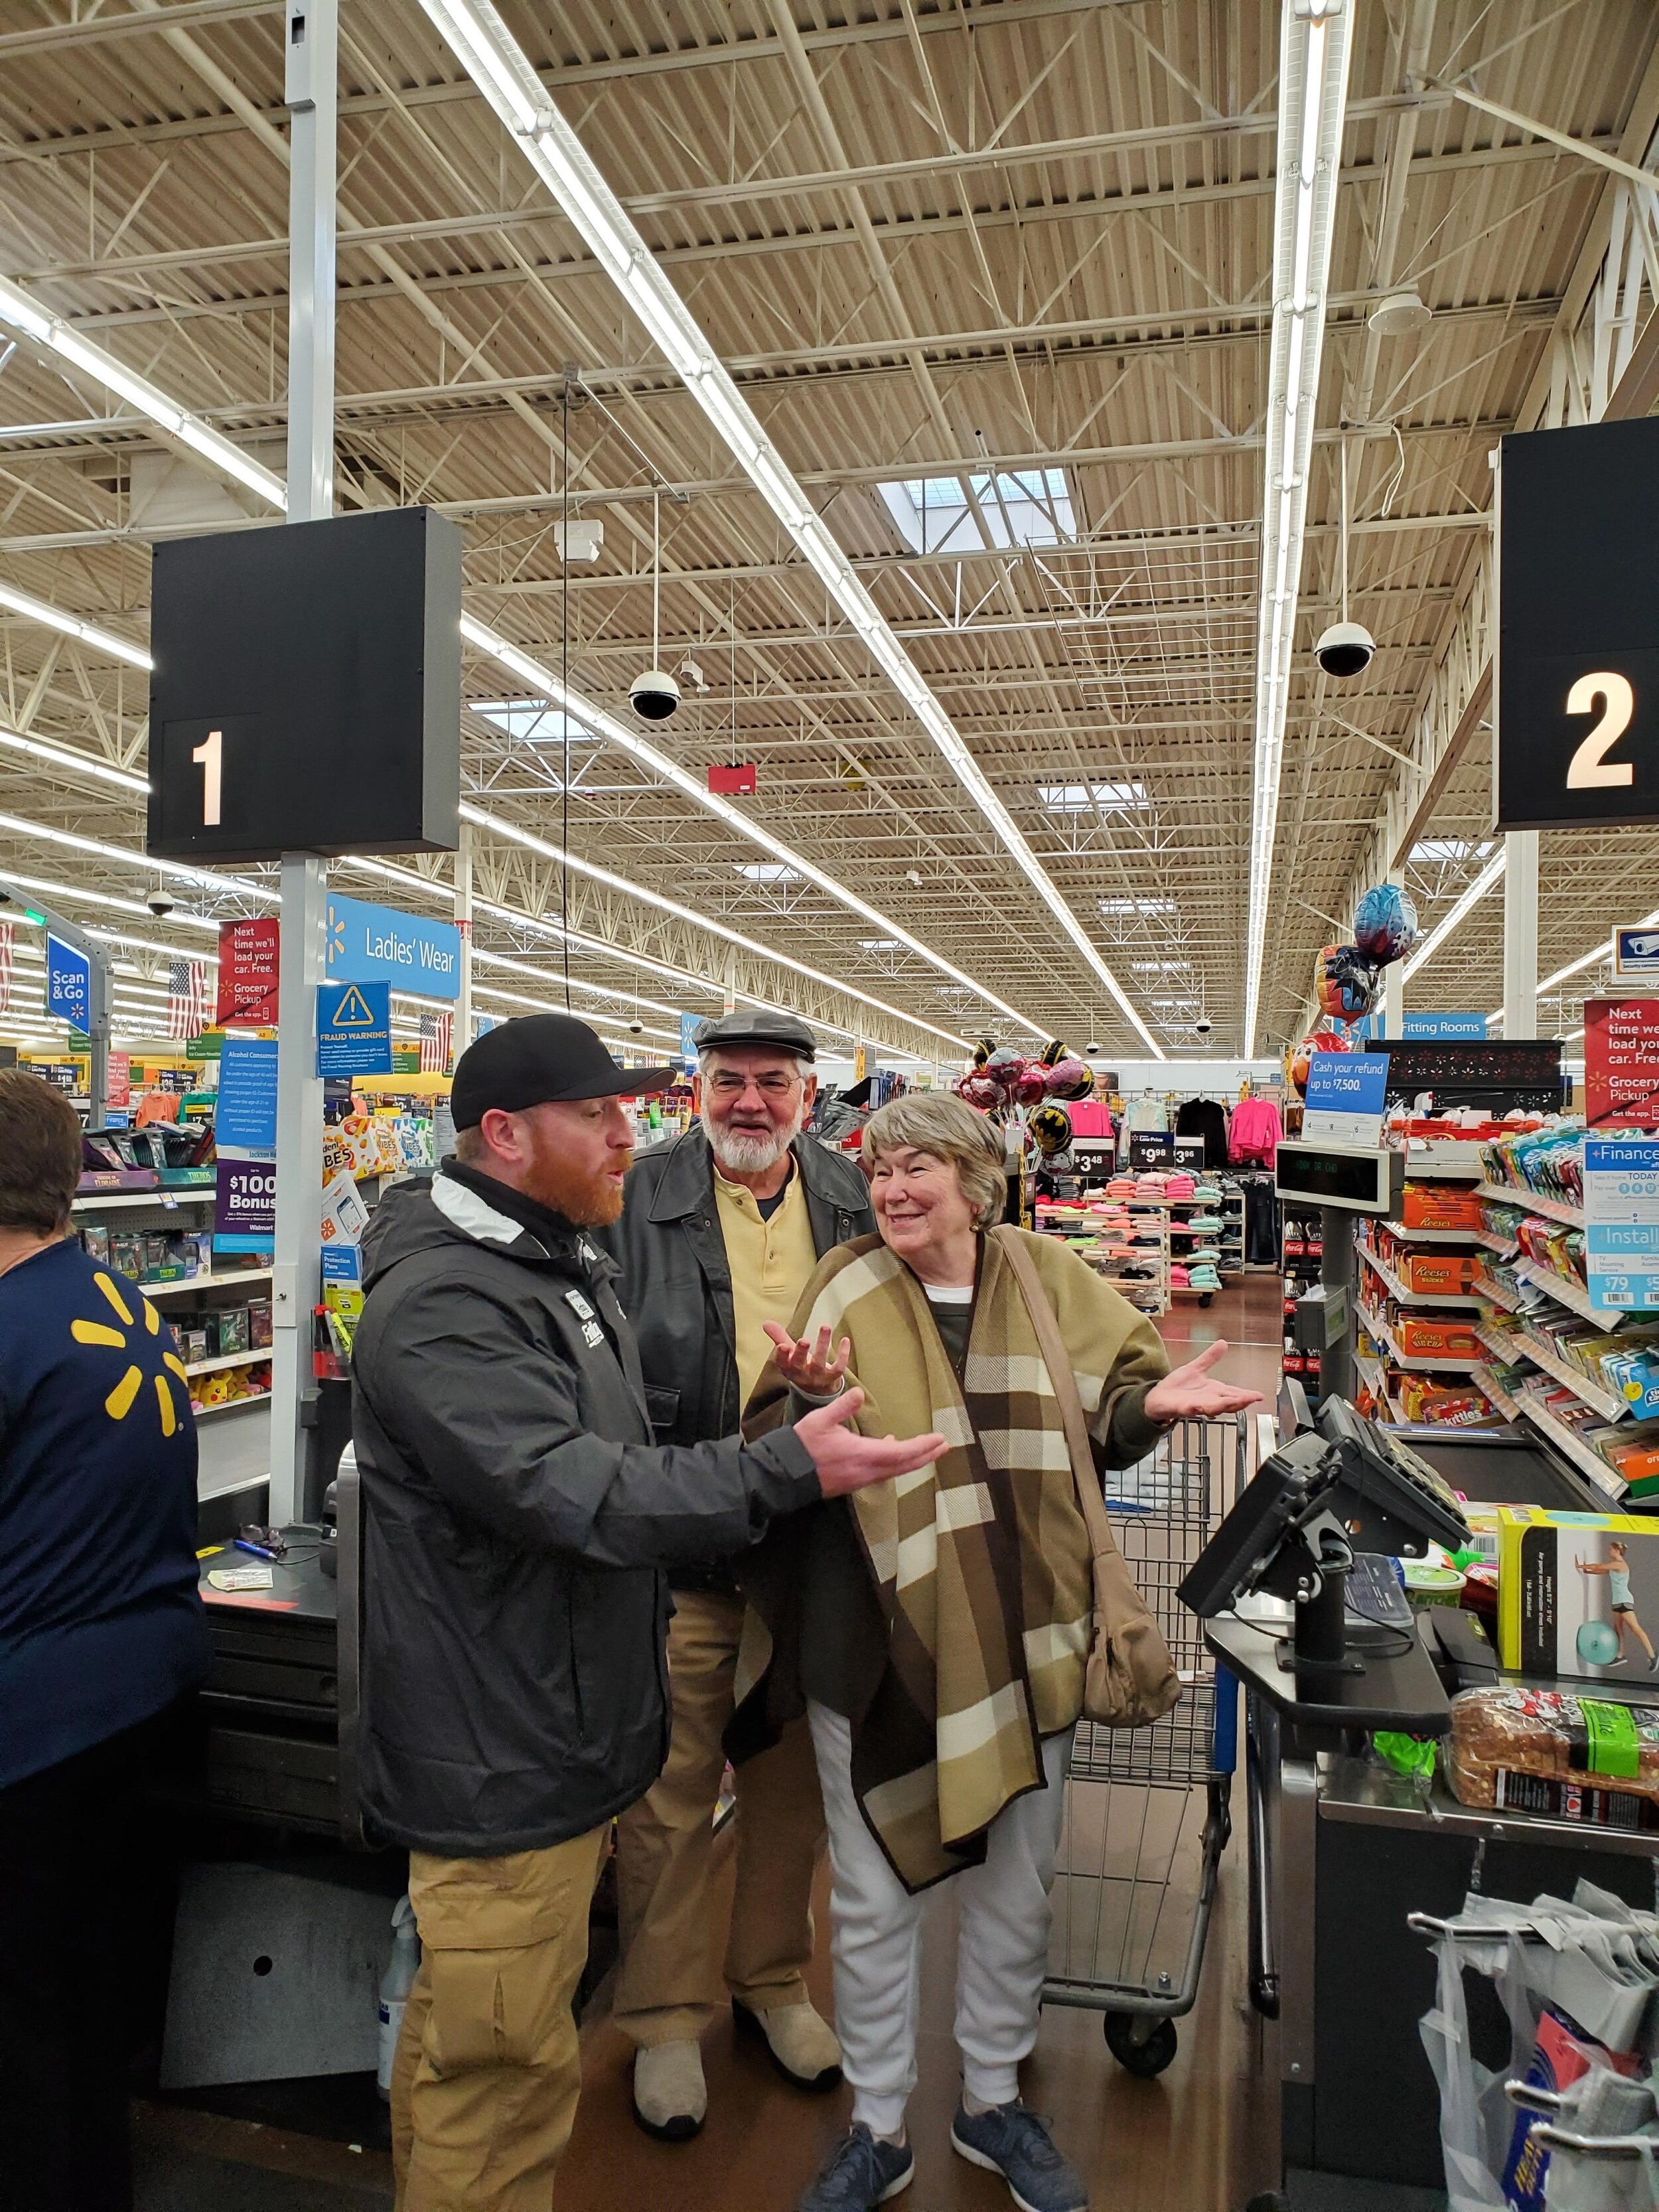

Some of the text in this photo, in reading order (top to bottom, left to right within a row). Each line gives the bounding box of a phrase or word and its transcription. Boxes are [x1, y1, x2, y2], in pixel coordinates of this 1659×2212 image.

[1566, 672, 1633, 789] 2
[192, 731, 222, 826] 1
[234, 926, 255, 936] Next
[234, 937, 275, 949] time we'll
[366, 927, 455, 973] Ladies' Wear
[234, 952, 273, 964] load your
[252, 964, 273, 974] Free.
[52, 970, 84, 984] Scan
[234, 984, 268, 994] Grocery
[234, 995, 261, 1005] Pickup
[1609, 1007, 1642, 1019] Next
[1402, 1021, 1479, 1035] Fitting Rooms
[1609, 1023, 1638, 1035] time
[348, 1031, 388, 1040] WARNING
[1609, 1037, 1636, 1049] load
[1609, 1052, 1659, 1065] car. Fre
[1313, 1061, 1384, 1076] Cash your refund
[1311, 1078, 1361, 1092] up to $7,500.
[1609, 1075, 1659, 1090] Grocery
[1611, 1089, 1649, 1103] Pickup
[1601, 1145, 1659, 1160] Finance
[230, 1175, 276, 1194] $100
[230, 1194, 276, 1209] Bonus
[1420, 1217, 1451, 1226] Reese's
[1607, 1227, 1659, 1244] Install
[324, 1256, 350, 1265] Protection
[1415, 1266, 1451, 1277] Reese's
[1605, 1276, 1628, 1291] $79
[1411, 1330, 1442, 1341] Reese's
